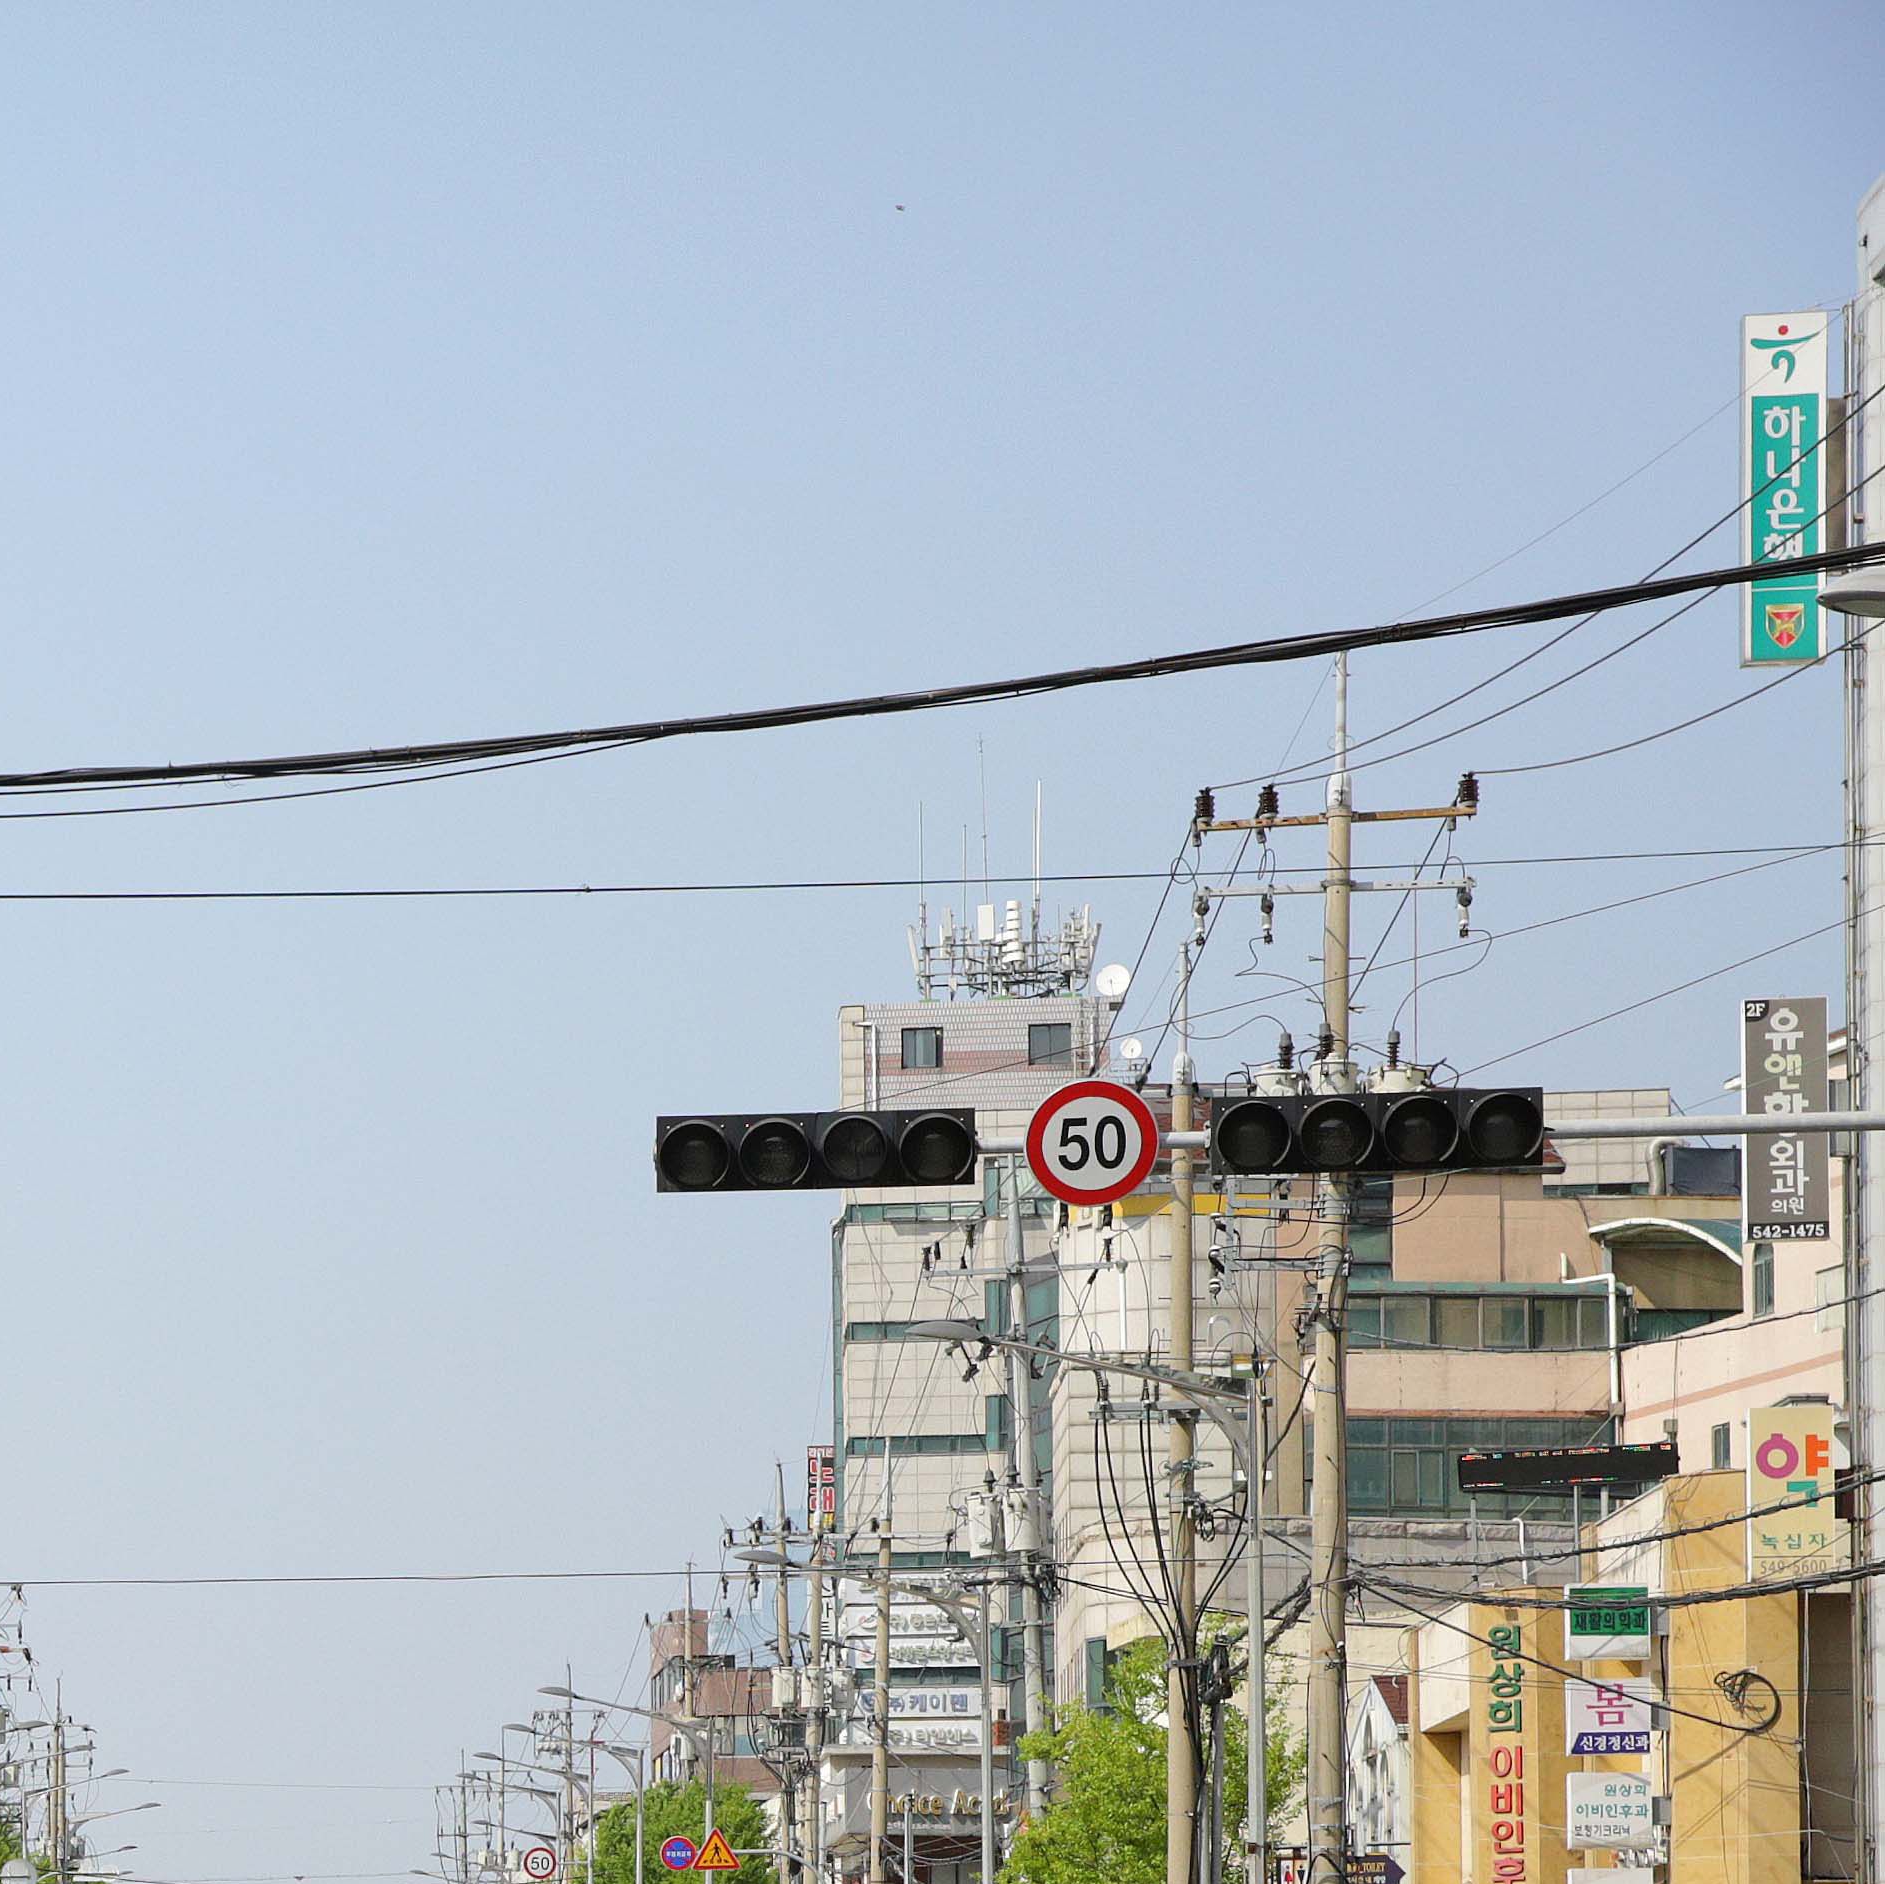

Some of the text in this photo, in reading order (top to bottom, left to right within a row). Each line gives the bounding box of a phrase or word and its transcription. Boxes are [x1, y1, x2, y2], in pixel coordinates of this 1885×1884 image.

[1763, 405, 1806, 559] 하나은행
[1746, 1003, 1766, 1017] 2F
[1057, 1115, 1127, 1171] 50
[1771, 1196, 1805, 1215] 의원
[1752, 1223, 1825, 1239] 542-1475
[1756, 1433, 1829, 1507] 약
[1761, 1533, 1827, 1550] 녹십자
[1487, 1625, 1524, 1733] 원상희
[1586, 1683, 1633, 1726] 봄
[1580, 1734, 1651, 1751] 신경정신과
[1604, 1784, 1647, 1797] 원상희
[1575, 1804, 1649, 1819] 이비인후과
[1574, 1824, 1631, 1837] 보청기크리닉
[531, 1857, 550, 1870] 50
